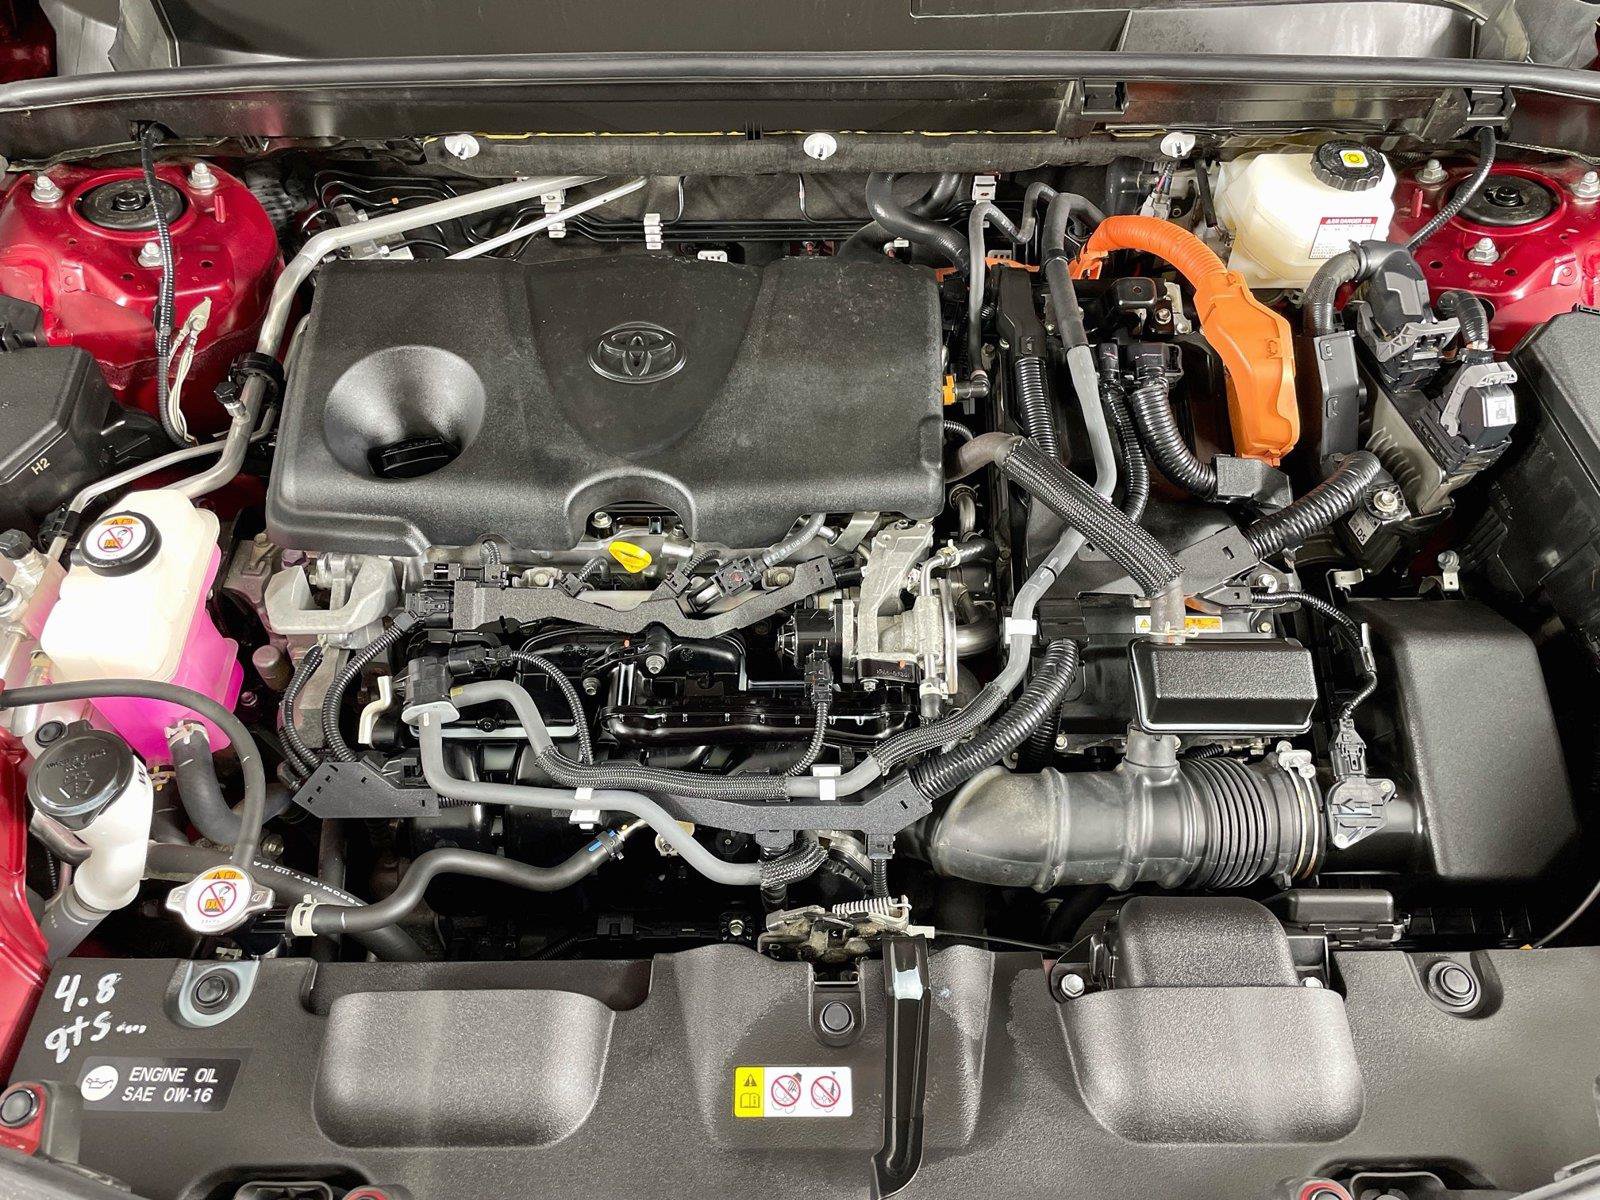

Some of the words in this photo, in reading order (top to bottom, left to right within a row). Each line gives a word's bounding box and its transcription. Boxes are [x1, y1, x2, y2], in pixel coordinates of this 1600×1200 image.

[31, 458, 51, 475] H2
[54, 973, 122, 1012] 4.8
[129, 1067, 187, 1083] ENGINE
[195, 1068, 218, 1083] OIL
[122, 1086, 156, 1102] SAE
[163, 1087, 214, 1103] 0W-16
